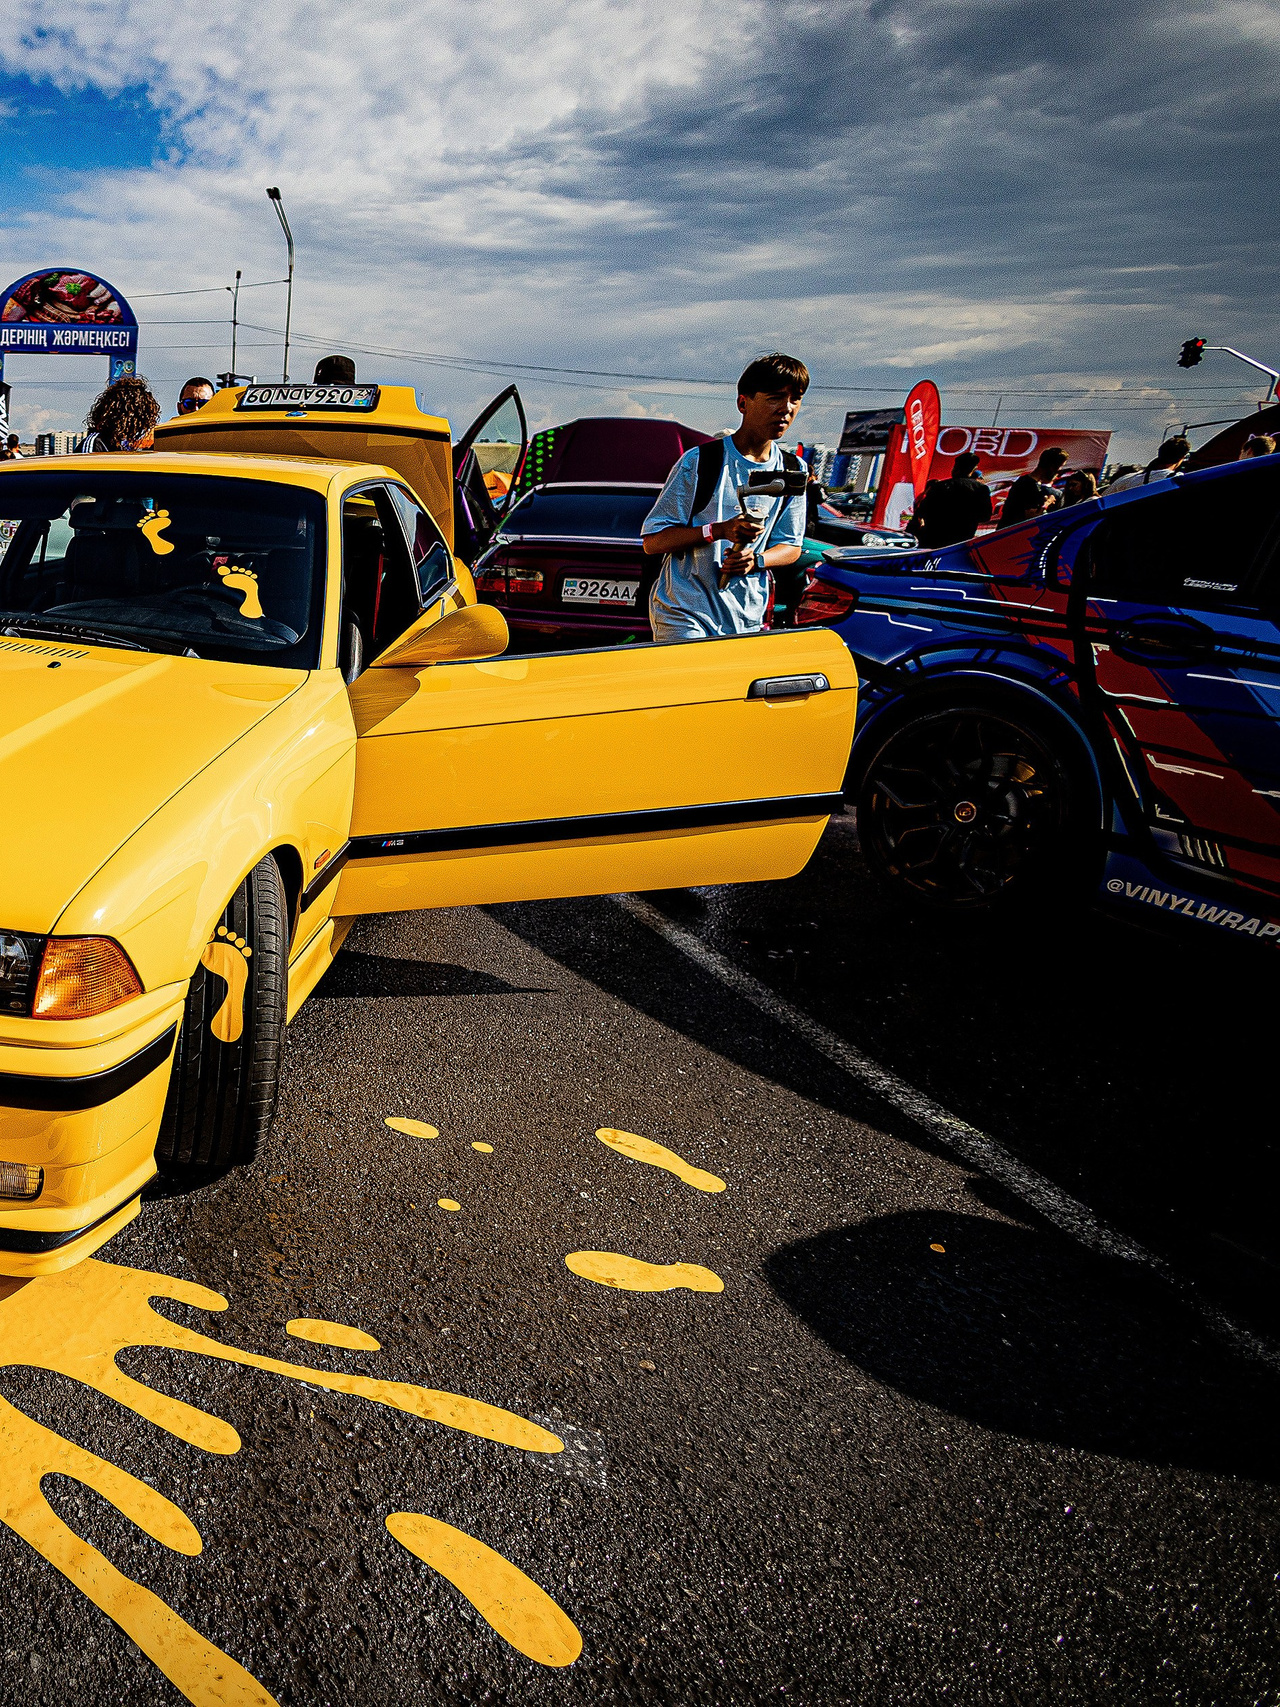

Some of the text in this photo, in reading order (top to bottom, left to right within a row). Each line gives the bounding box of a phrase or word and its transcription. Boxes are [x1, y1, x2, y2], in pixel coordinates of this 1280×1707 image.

[52, 329, 130, 348] ЖӘРМЕҢКЕСІ
[248, 388, 272, 404] 09
[276, 388, 354, 405] 036ADN
[563, 588, 577, 596] KZ
